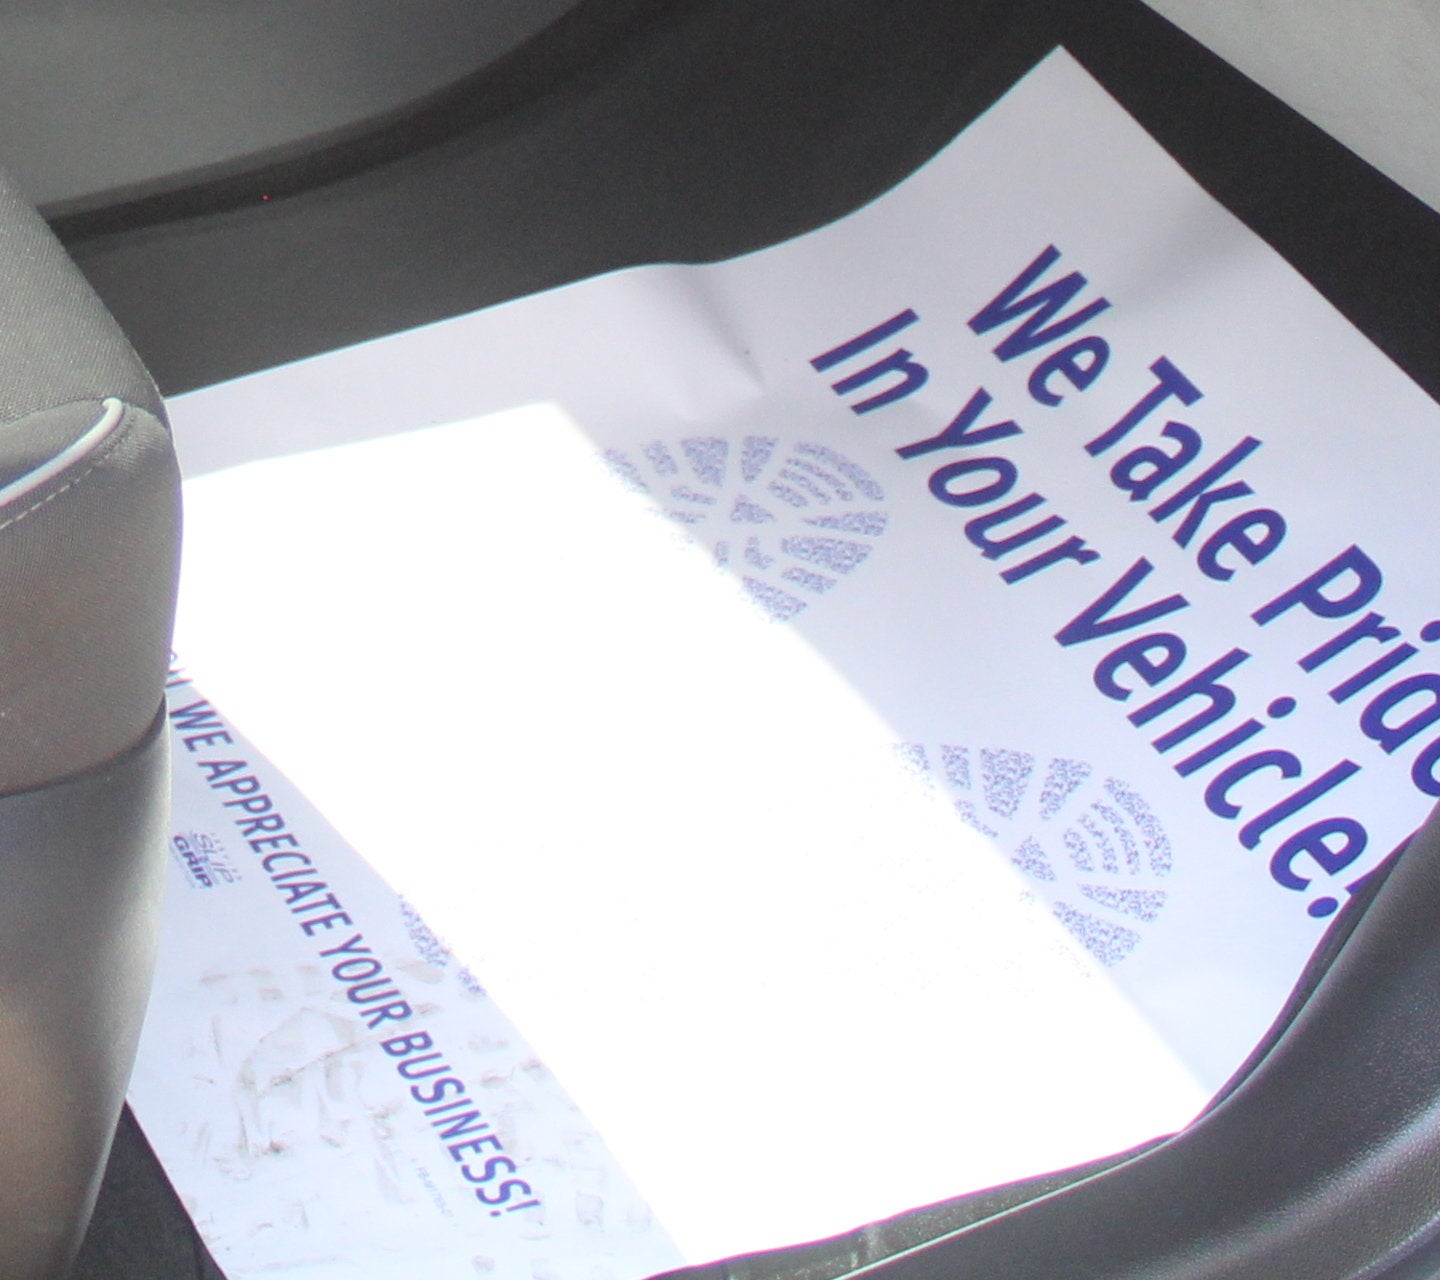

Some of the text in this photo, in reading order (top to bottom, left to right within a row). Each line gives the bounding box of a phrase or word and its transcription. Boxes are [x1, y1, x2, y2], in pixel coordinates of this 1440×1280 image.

[808, 307, 930, 416] In
[894, 386, 1101, 585] Your
[966, 243, 1113, 409] We
[1082, 354, 1288, 583] Take
[168, 698, 542, 1218] WE APPRECIATE YOUR BUSINESS!
